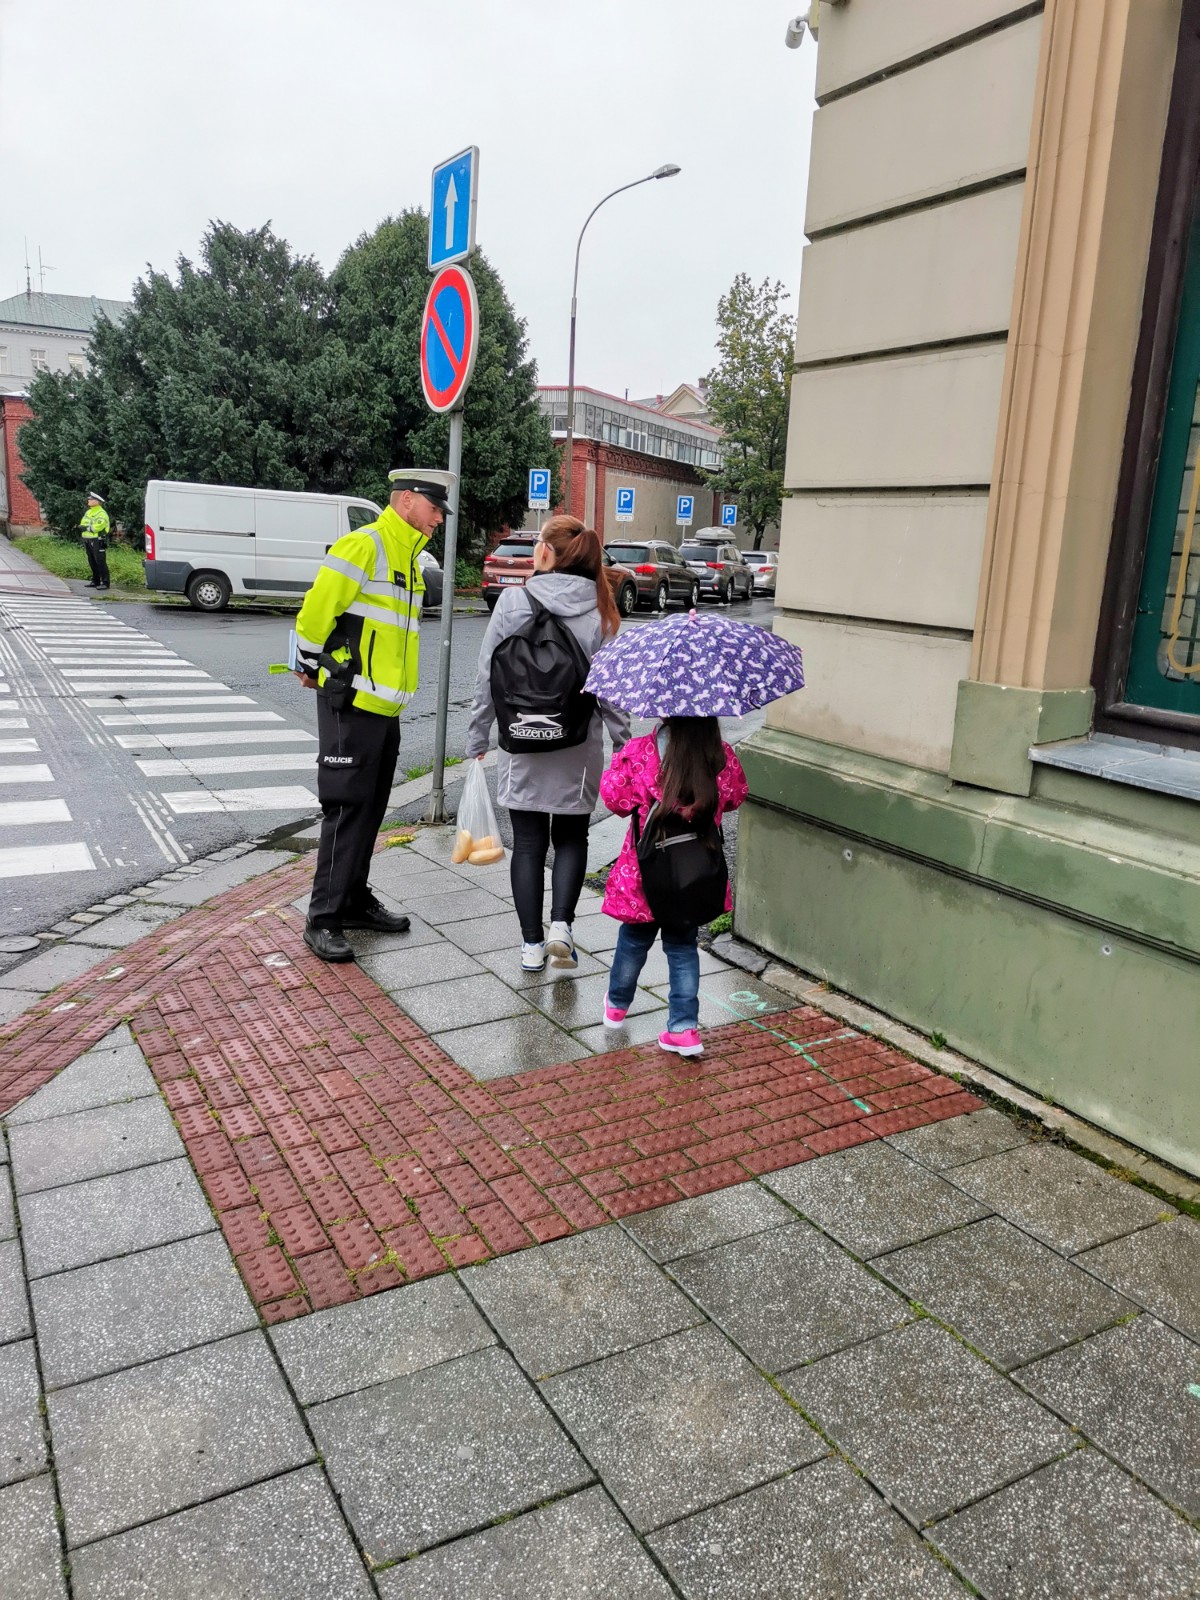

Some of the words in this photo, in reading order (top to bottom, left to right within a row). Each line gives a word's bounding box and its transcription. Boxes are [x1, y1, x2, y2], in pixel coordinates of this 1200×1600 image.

[534, 474, 545, 491] P
[620, 491, 631, 507] P
[680, 499, 690, 512] P
[725, 507, 734, 519] P
[508, 723, 564, 740] Slazenger
[323, 755, 353, 764] POLICIE
